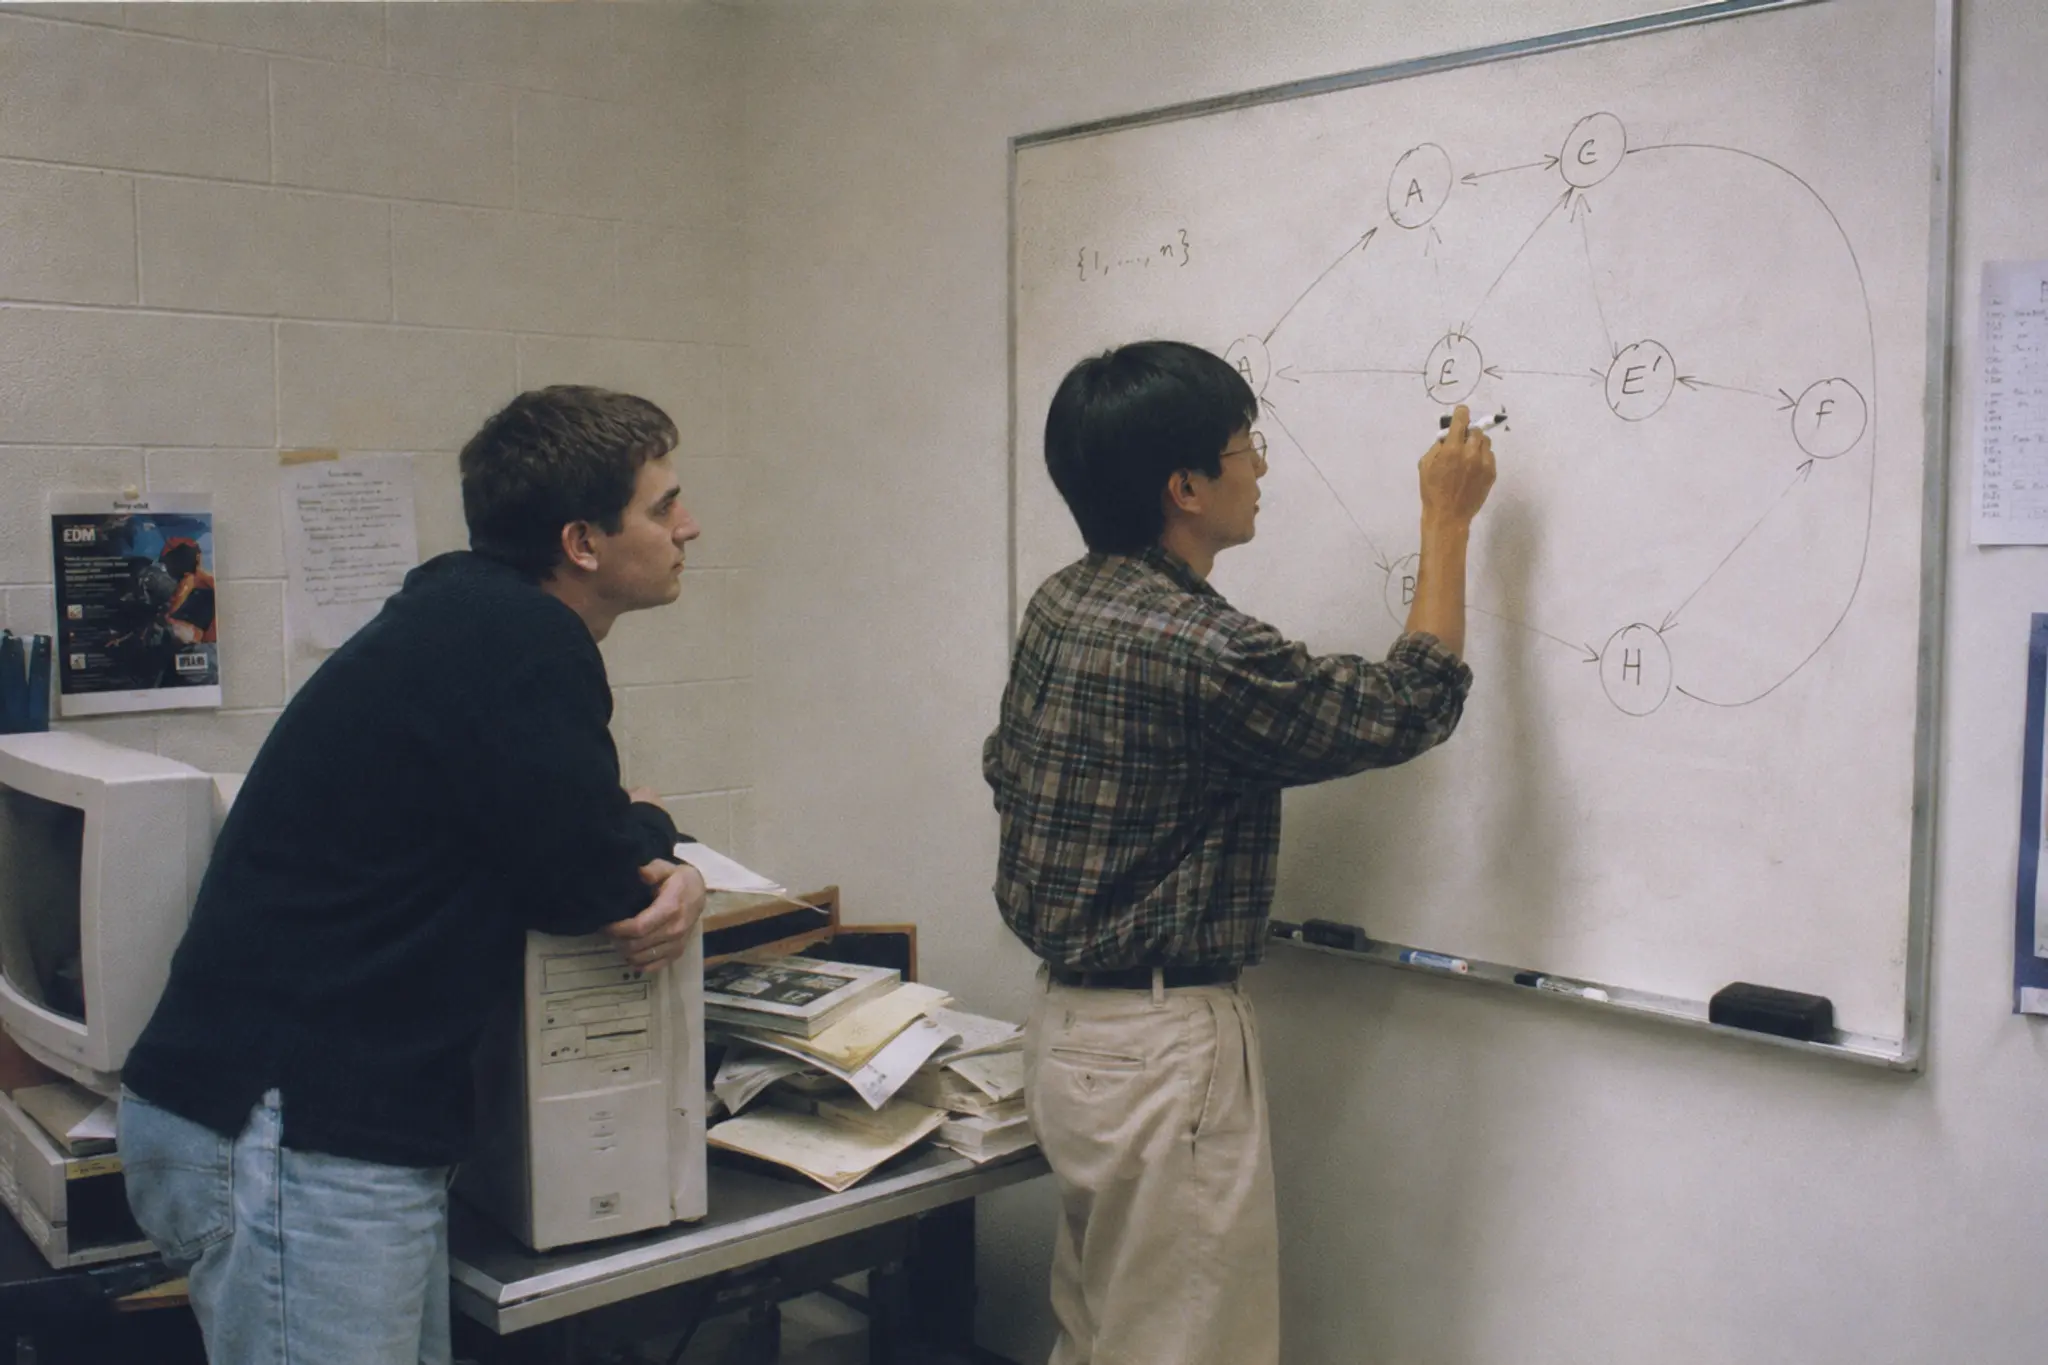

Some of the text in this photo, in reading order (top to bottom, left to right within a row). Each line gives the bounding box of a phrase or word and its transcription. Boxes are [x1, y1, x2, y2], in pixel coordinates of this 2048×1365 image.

[1405, 178, 1424, 207] A
[1439, 358, 1459, 386] E
[63, 528, 96, 543] EDM
[1622, 648, 1641, 686] H
